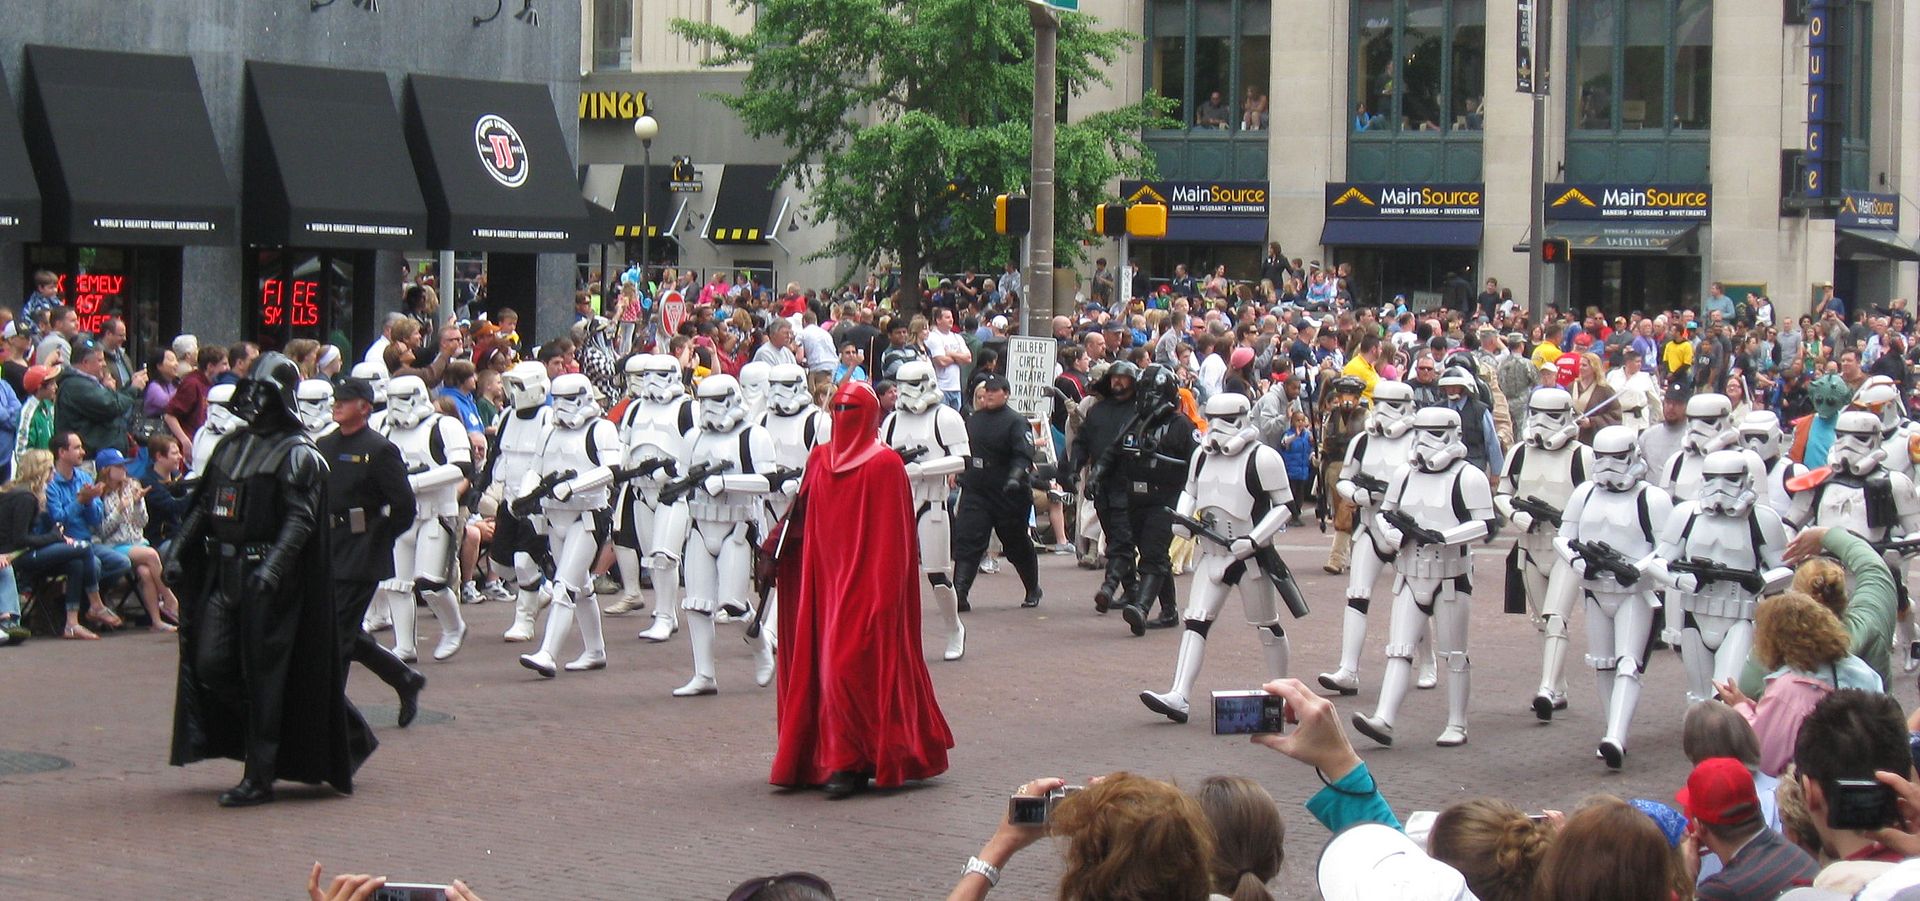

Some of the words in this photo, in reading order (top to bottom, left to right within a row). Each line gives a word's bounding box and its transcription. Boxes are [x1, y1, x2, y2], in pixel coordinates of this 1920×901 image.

[1172, 185, 1265, 203] MainSource
[1381, 187, 1479, 205] MainSource
[1603, 188, 1706, 207] MainSource
[1859, 198, 1893, 215] MainSource
[263, 280, 318, 306] FEE
[63, 294, 103, 313] AST
[264, 306, 318, 324] SMLLS
[1017, 341, 1047, 354] HILBERT
[1019, 356, 1044, 368] CIRCLE
[1015, 370, 1046, 382] THEATRE
[1018, 399, 1038, 411] ONLY
